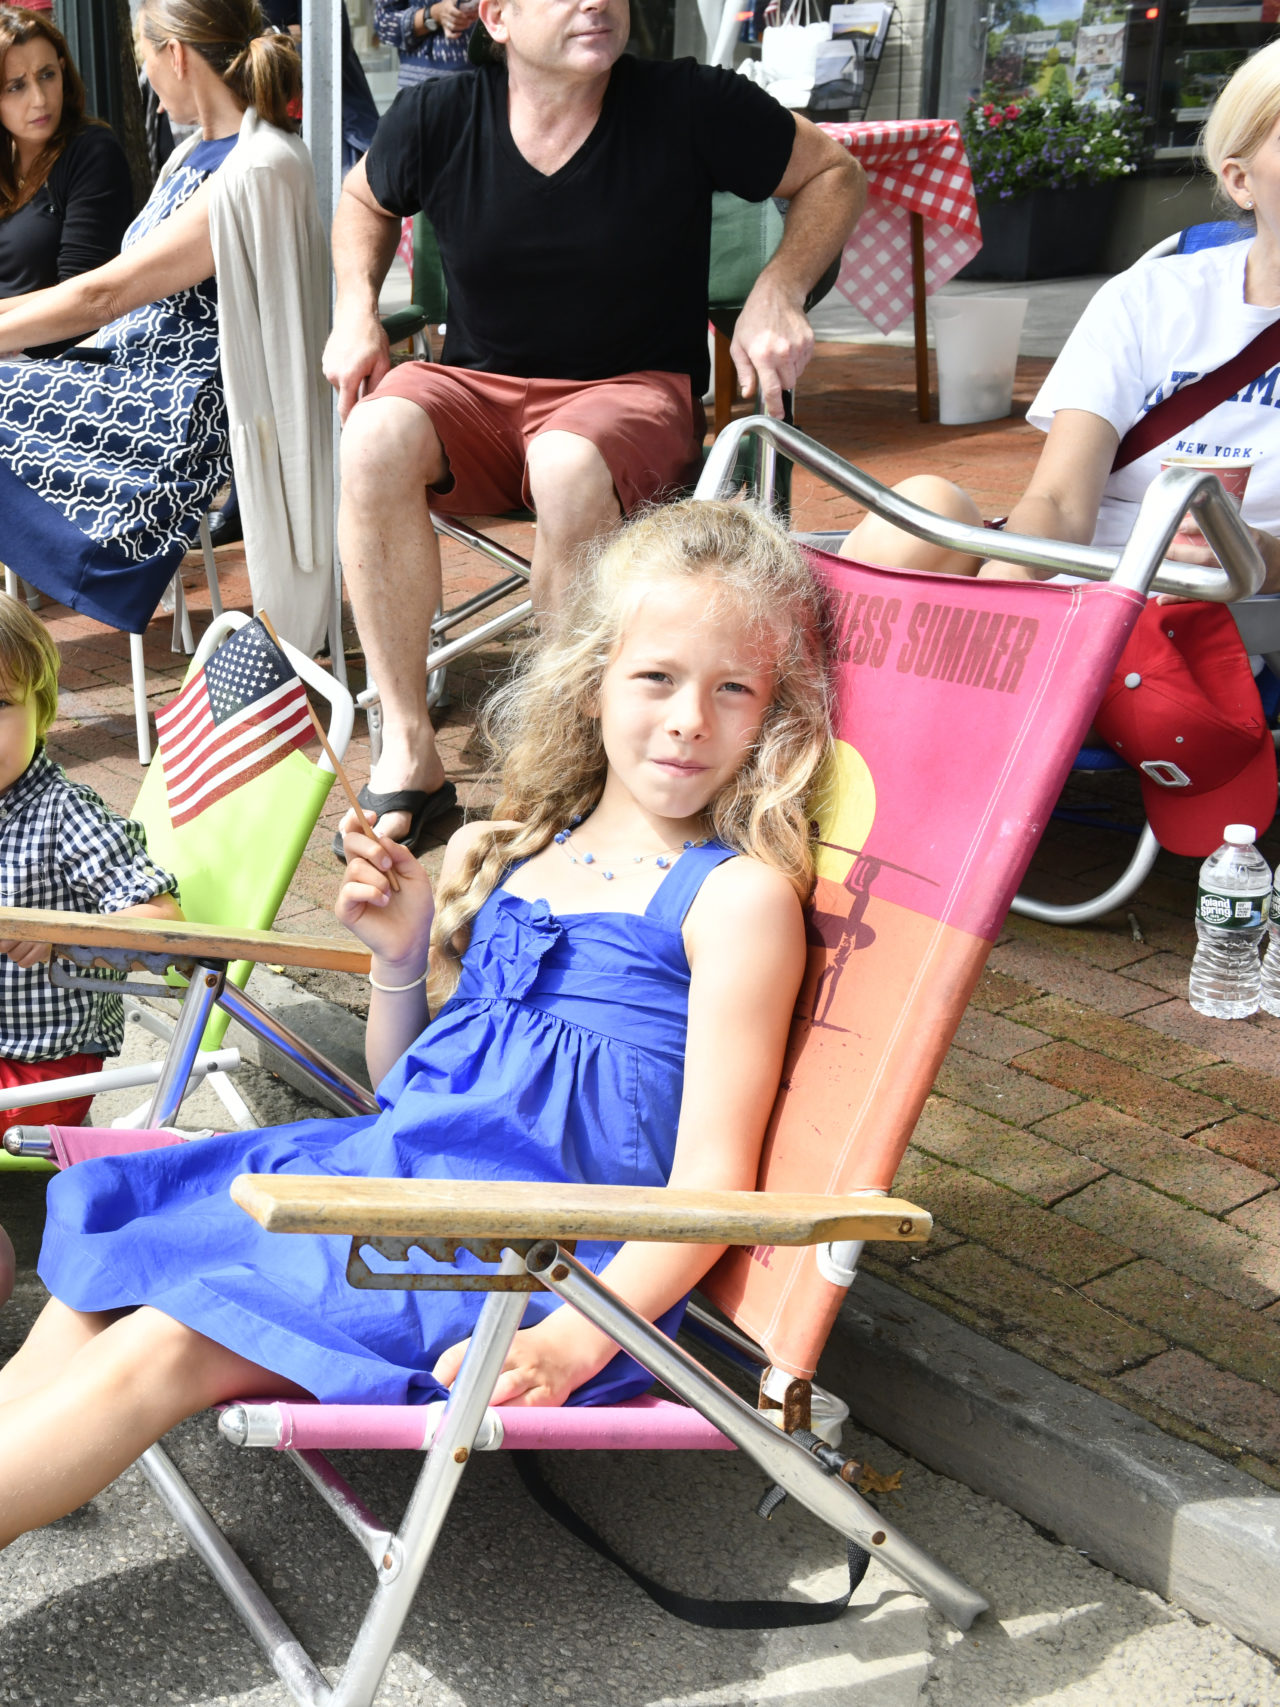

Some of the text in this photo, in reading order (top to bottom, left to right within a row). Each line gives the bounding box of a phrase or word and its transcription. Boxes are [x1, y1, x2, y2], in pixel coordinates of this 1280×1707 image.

[1175, 440, 1253, 458] NEW YORK
[896, 601, 1040, 694] SUMMER
[1201, 896, 1231, 909] Poland
[1201, 906, 1232, 918] Spring
